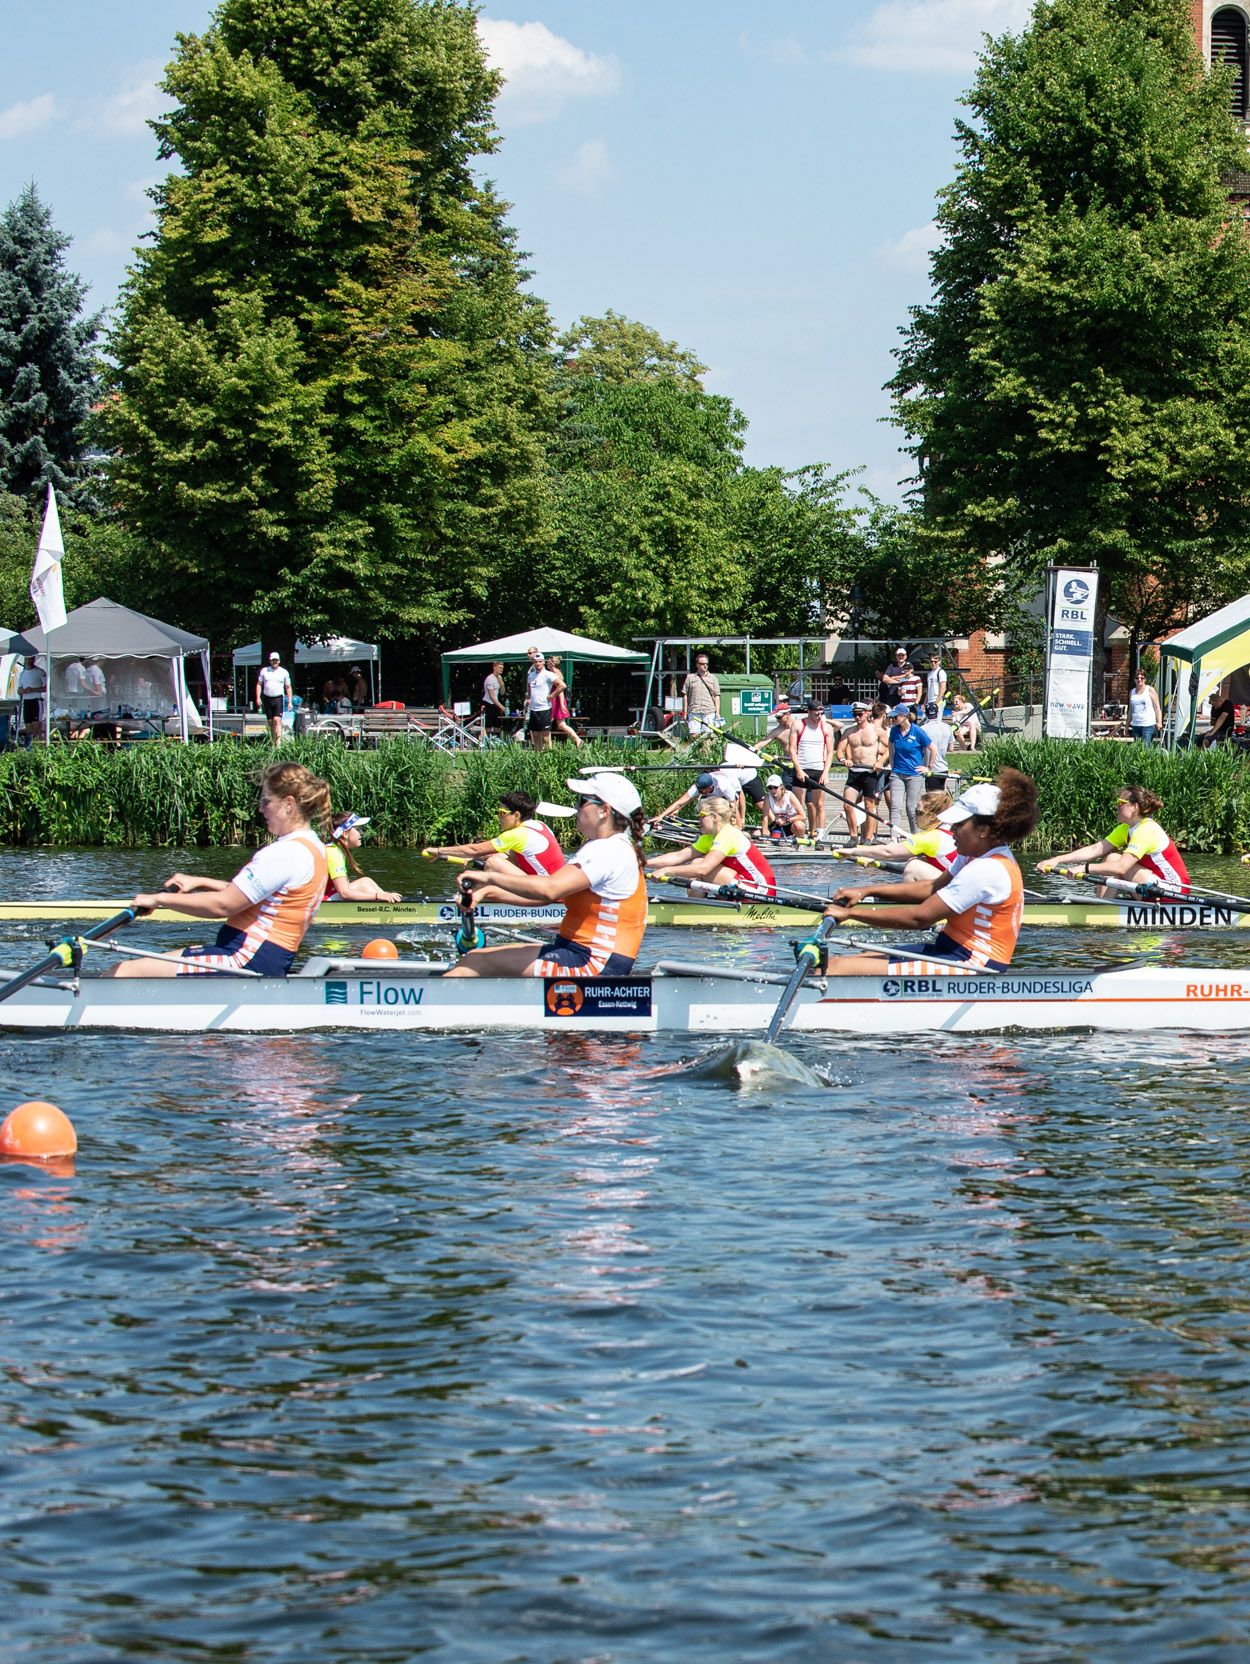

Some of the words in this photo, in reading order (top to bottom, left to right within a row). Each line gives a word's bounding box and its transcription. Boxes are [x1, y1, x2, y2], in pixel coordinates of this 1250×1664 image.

[1061, 609, 1088, 621] RBL
[1055, 632, 1076, 640] STARK.
[1054, 639, 1083, 647] SCHNELL.
[743, 904, 777, 921] Melitta
[1127, 906, 1232, 926] MINDEN
[359, 981, 424, 1005] Flow
[584, 986, 650, 998] RUHR-ACHTER
[903, 979, 943, 993] RBL
[947, 980, 1094, 995] RUDER-BUNDESLIGA
[360, 1008, 422, 1017] FlowWaterjet.com
